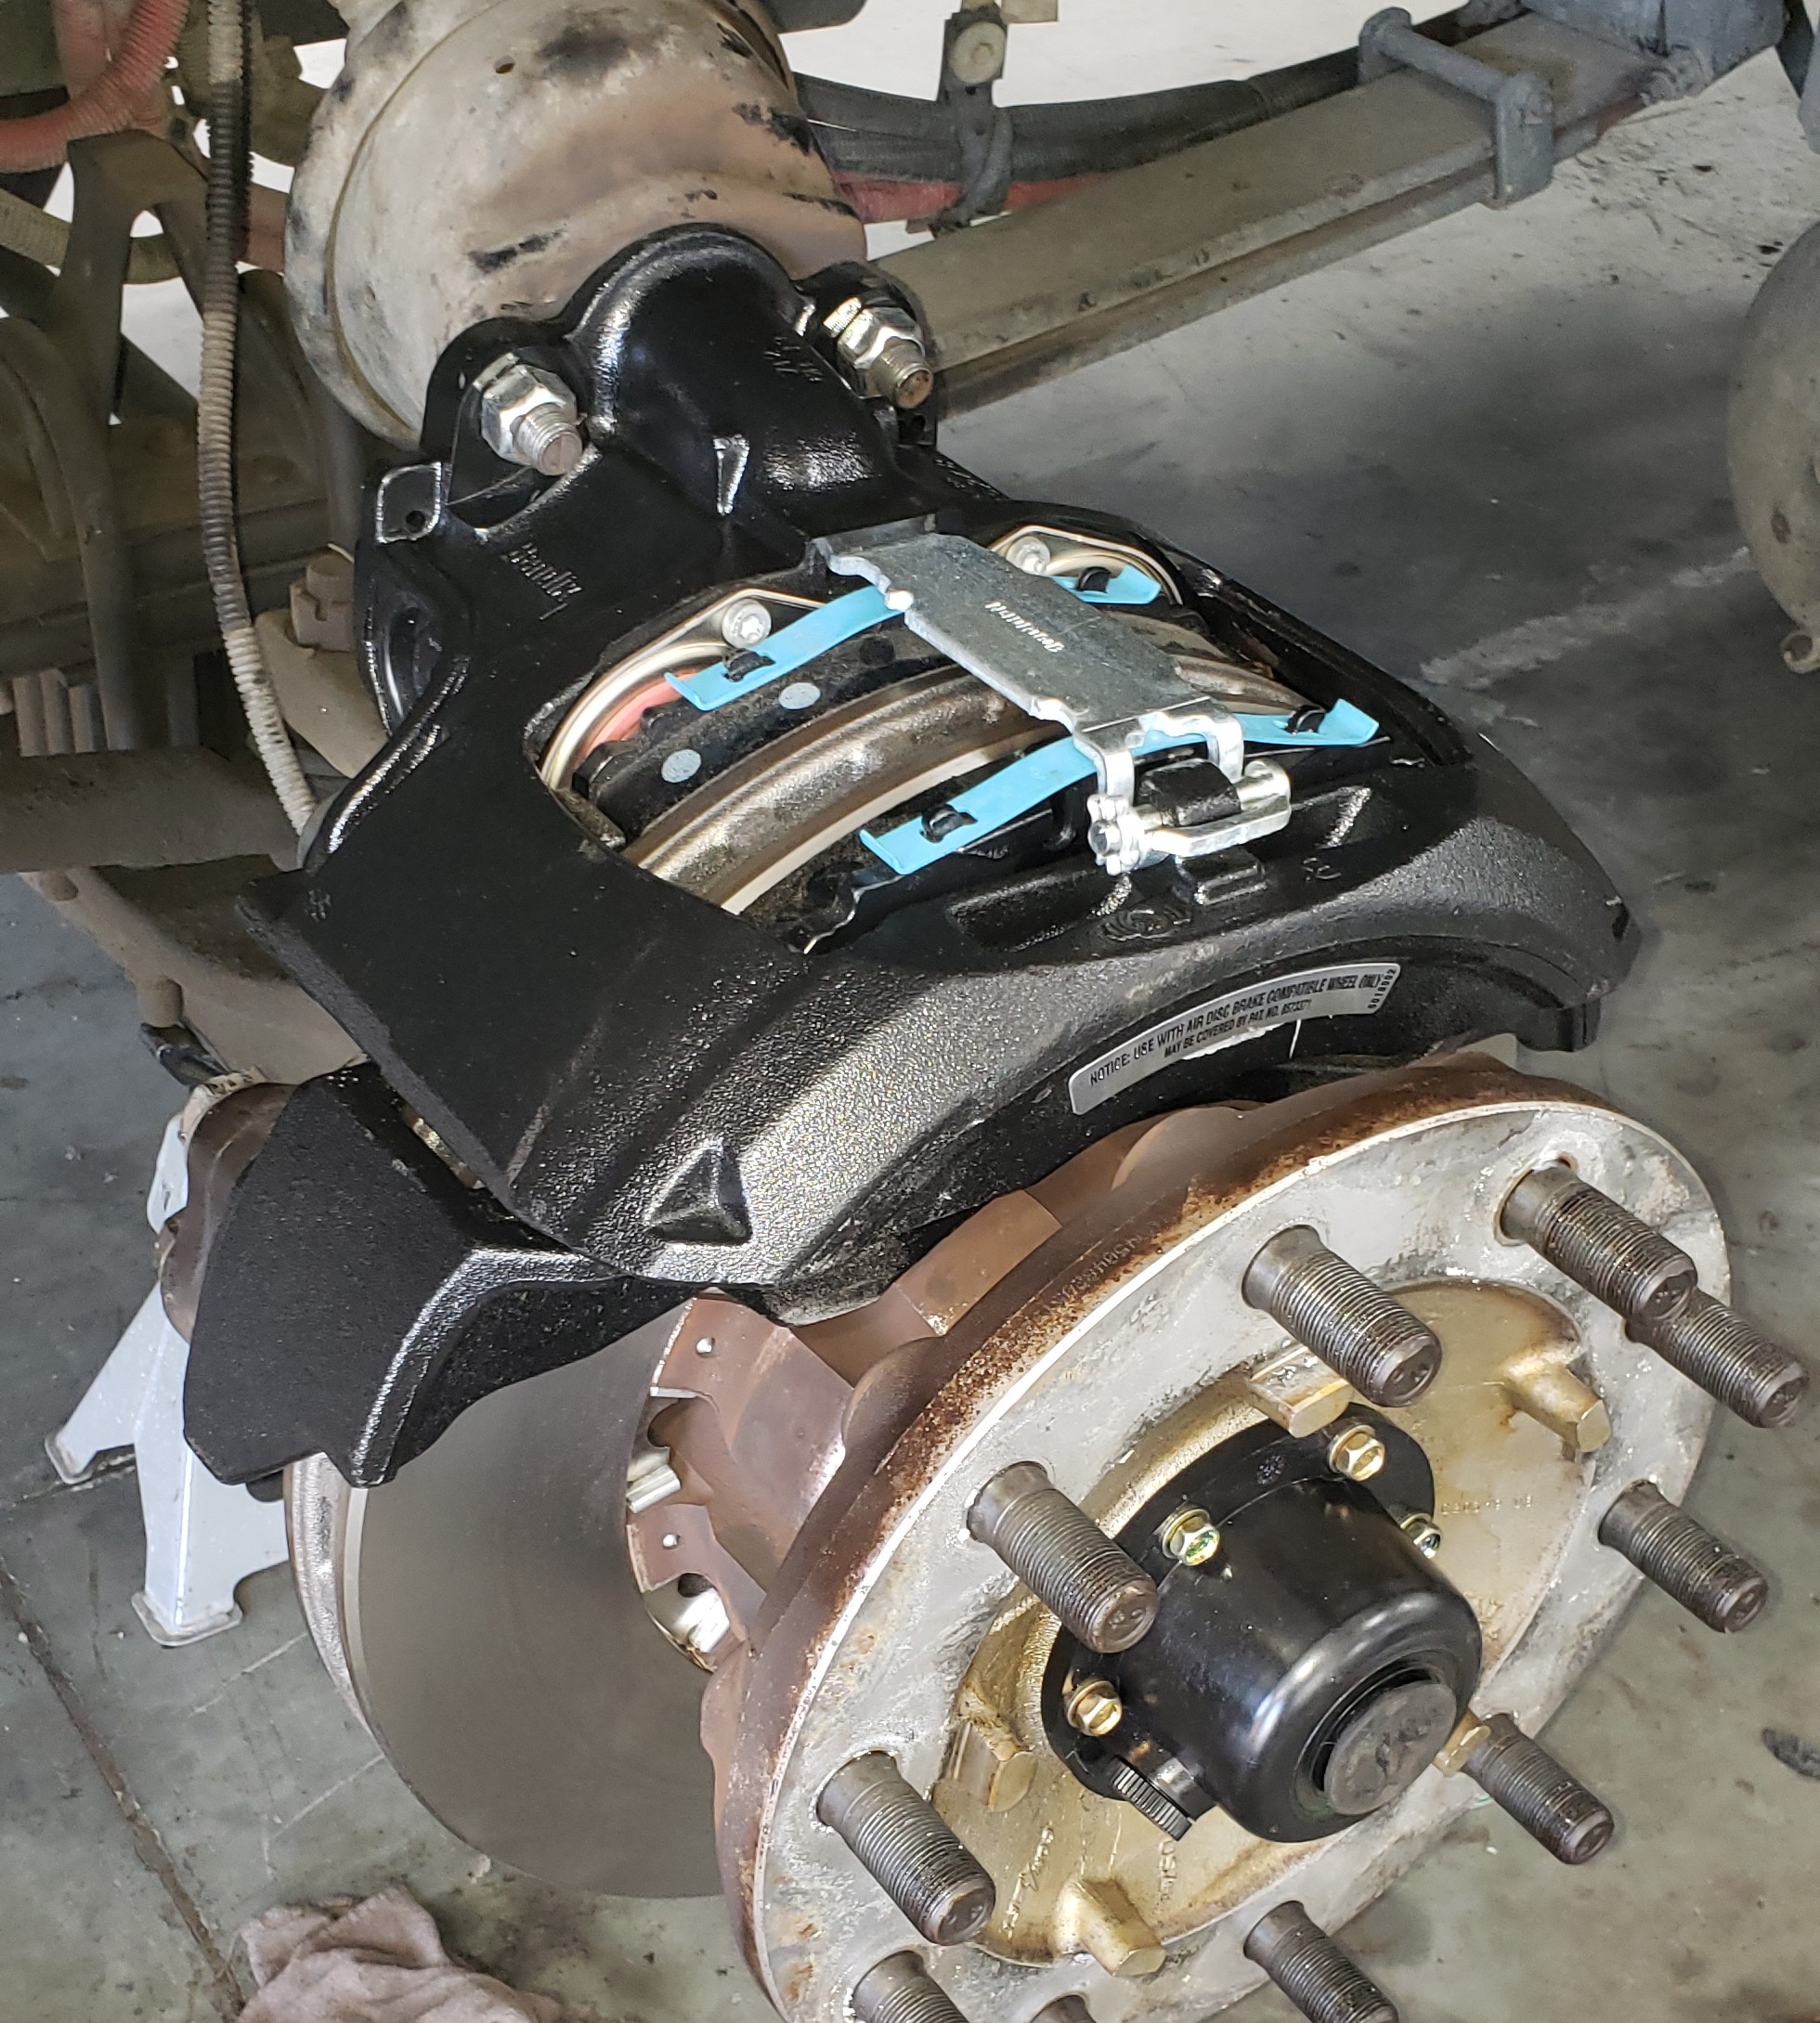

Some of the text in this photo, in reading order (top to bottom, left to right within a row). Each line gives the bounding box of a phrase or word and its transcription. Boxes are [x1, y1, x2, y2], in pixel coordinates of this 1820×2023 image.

[1089, 1053, 1130, 1086] NOTICE:
[1133, 1038, 1154, 1060] USE
[1157, 1024, 1185, 1047] WITH
[1186, 1015, 1204, 1034] AIR
[1206, 1004, 1230, 1026] DISC
[1231, 992, 1267, 1015] BRAKE
[1164, 1041, 1182, 1058] MAY
[1183, 1034, 1195, 1050] BE
[1196, 1018, 1236, 1044] COVERED
[1237, 1016, 1247, 1028] BY
